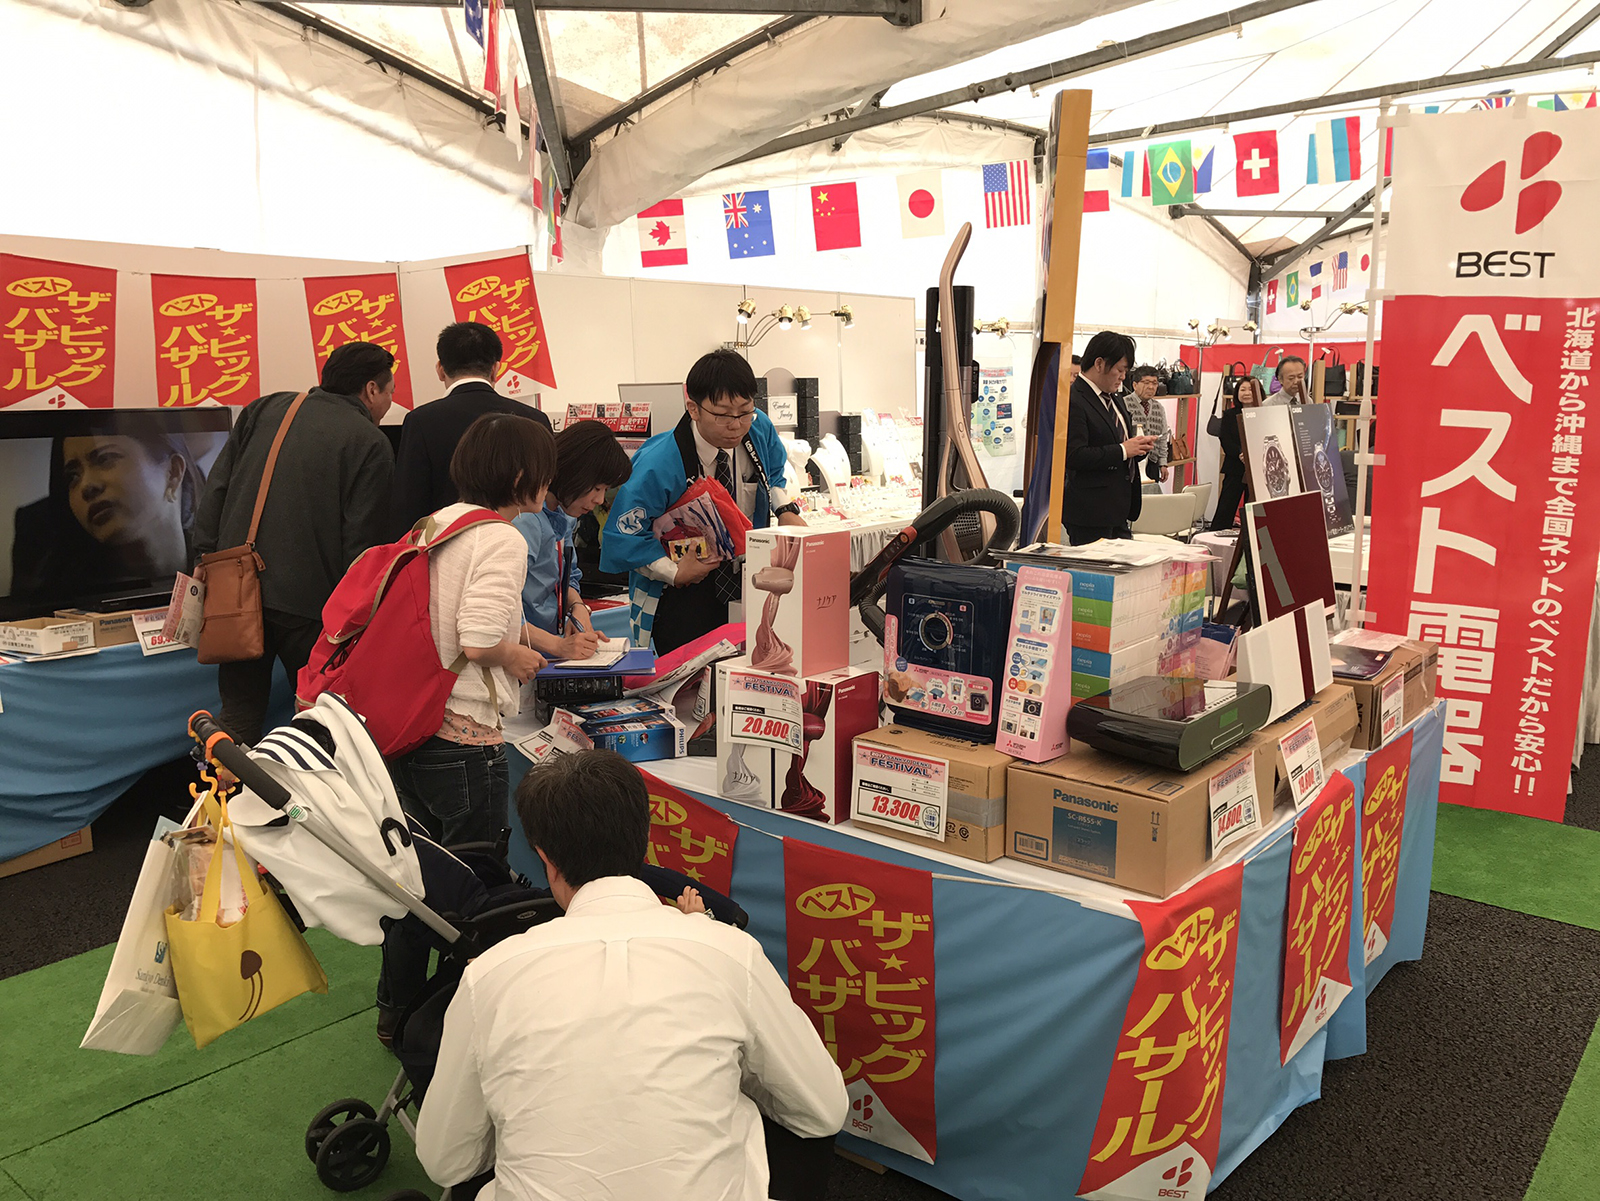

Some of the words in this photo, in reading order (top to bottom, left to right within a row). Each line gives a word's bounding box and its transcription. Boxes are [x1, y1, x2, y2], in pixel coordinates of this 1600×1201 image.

[1455, 250, 1555, 279] BEST
[12, 278, 68, 294] ベスト
[460, 278, 500, 301] ベスト
[163, 295, 212, 314] ベスト
[317, 291, 362, 313] ベスト
[2, 307, 60, 391] バザール
[160, 322, 209, 407] バザール
[748, 537, 770, 545] Panasonic
[805, 540, 824, 548] Panasonic
[99, 615, 132, 627] Panason
[745, 682, 795, 698] FESTIVAL
[741, 715, 790, 739] 20,800
[870, 757, 932, 778] FESTIVAL
[871, 795, 921, 822] 13,300
[1053, 788, 1119, 814] Panasonic
[1299, 811, 1333, 869] ベスト
[801, 885, 872, 913] ベスト
[1153, 913, 1211, 964] ベスト
[1285, 857, 1328, 1028] バザール
[1090, 975, 1201, 1163] バザール
[851, 1118, 874, 1134] BEST
[1158, 1188, 1189, 1199] BEST
